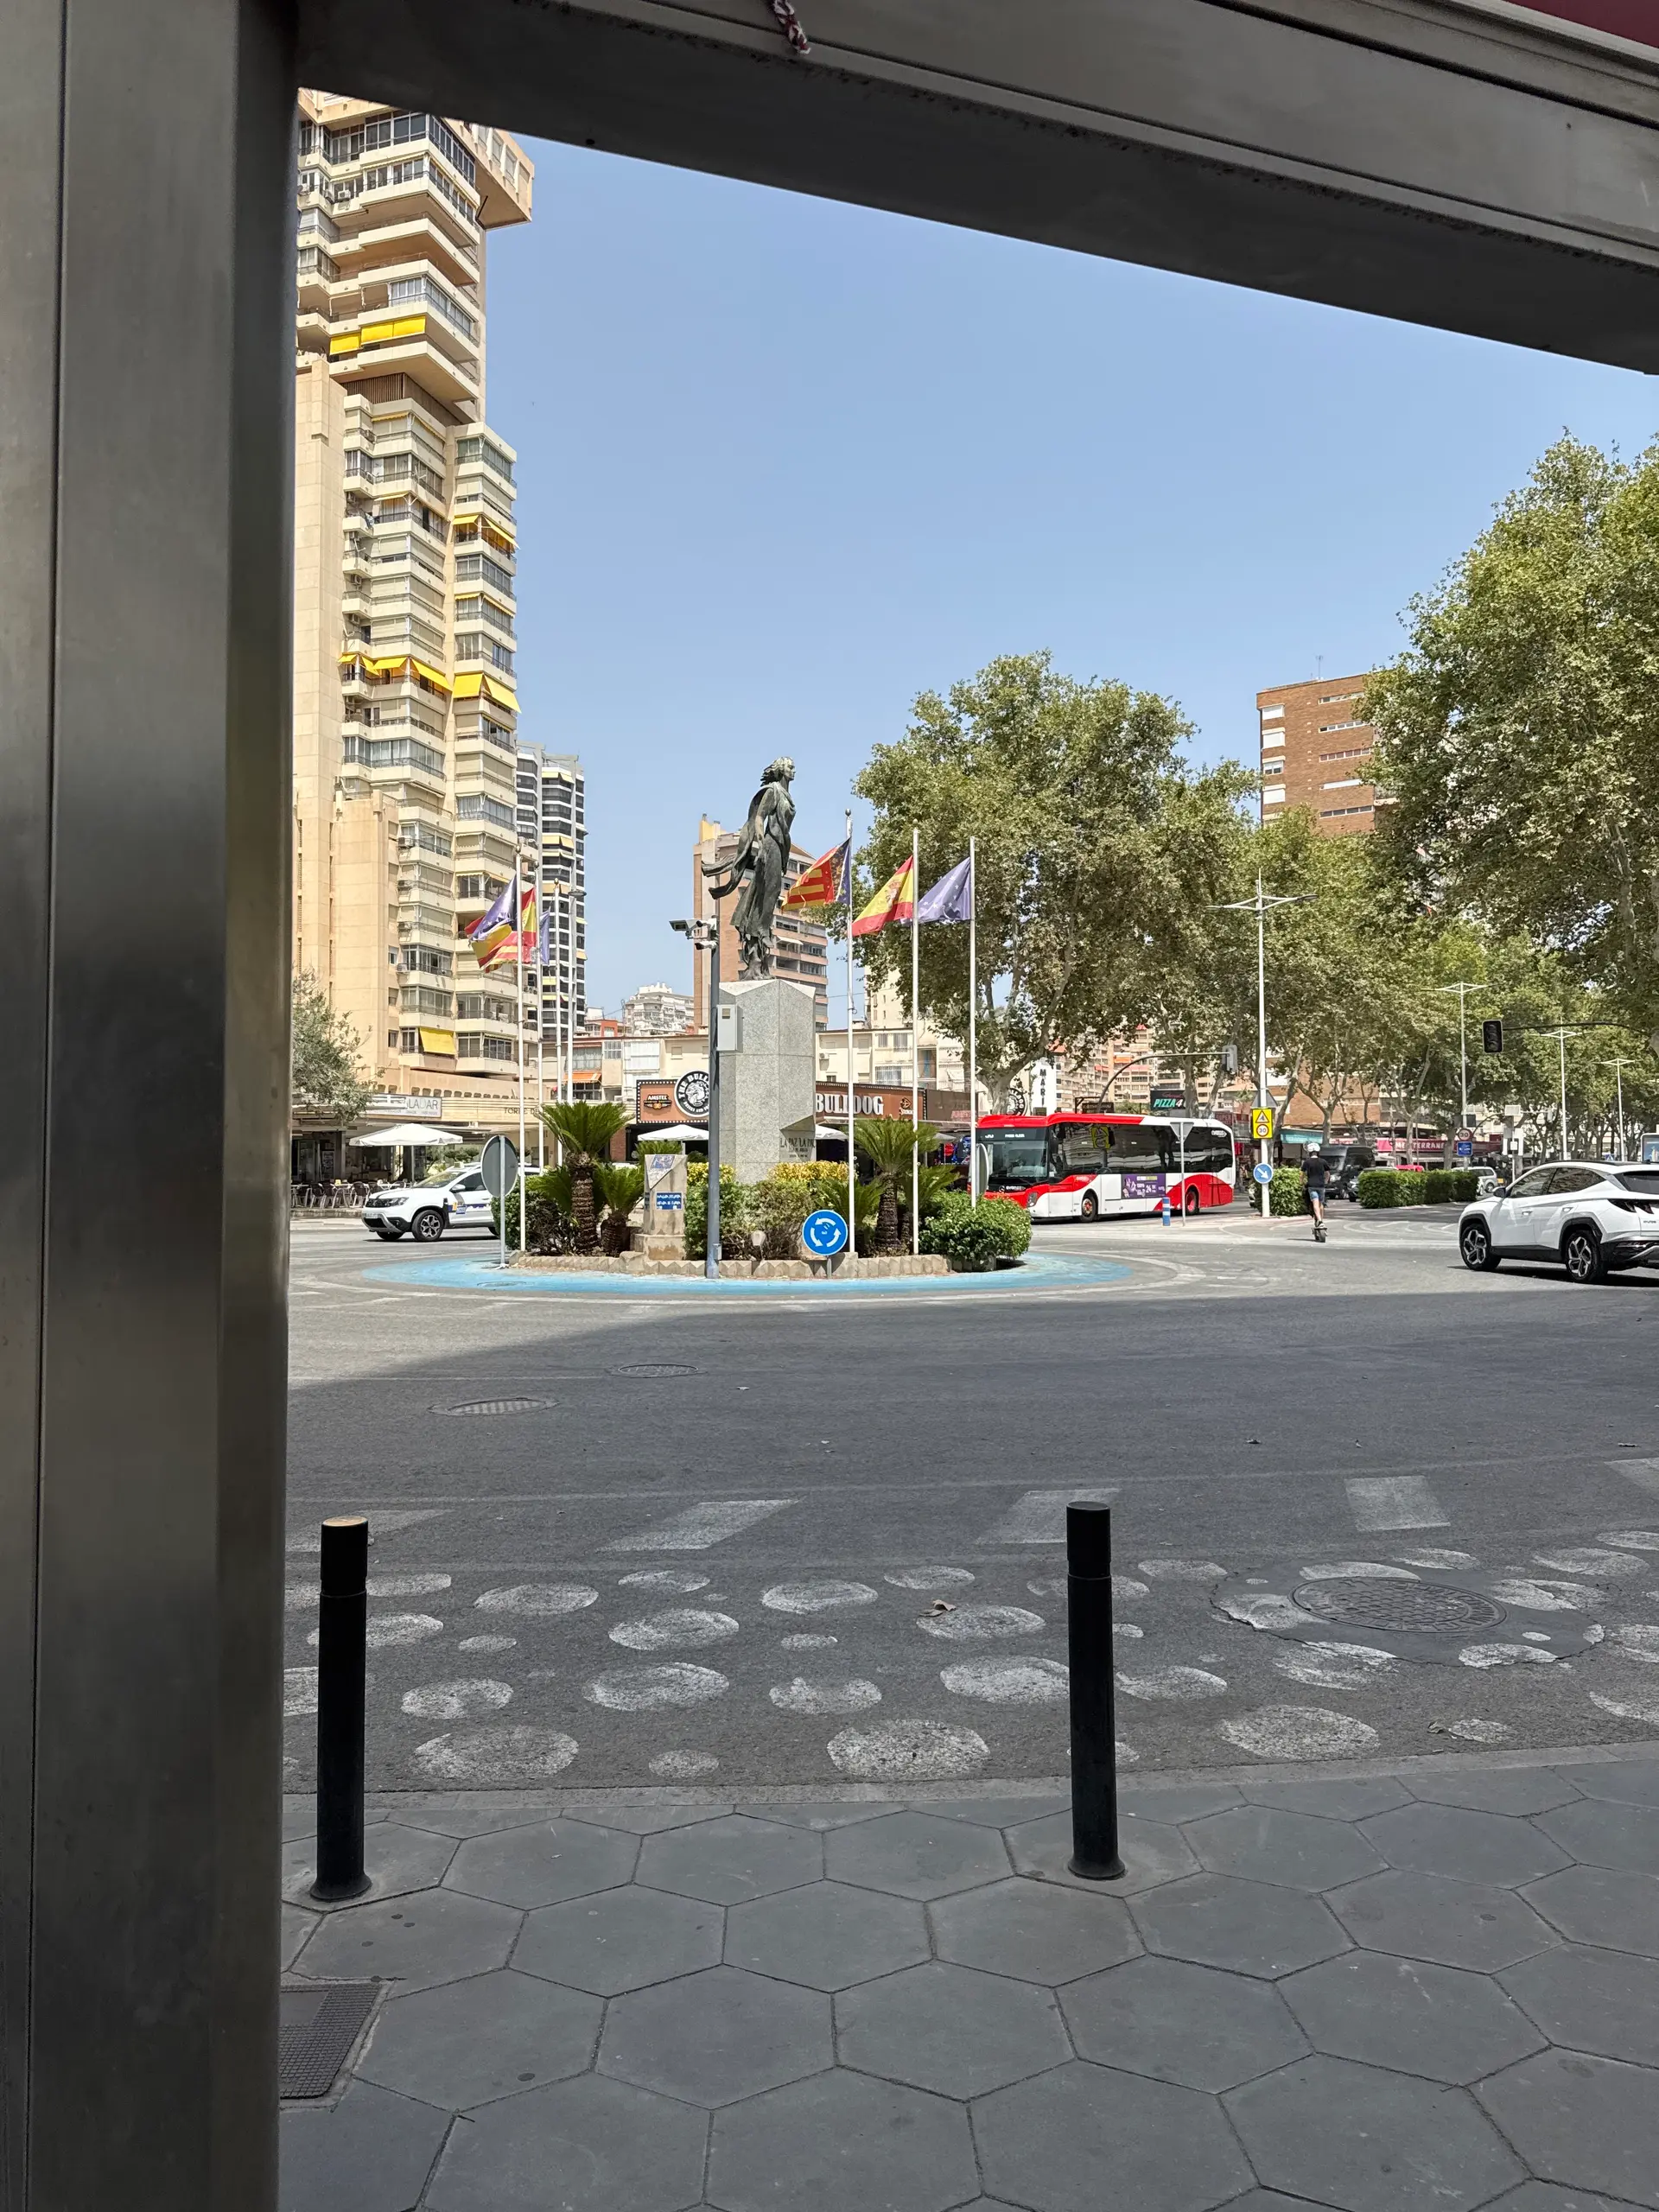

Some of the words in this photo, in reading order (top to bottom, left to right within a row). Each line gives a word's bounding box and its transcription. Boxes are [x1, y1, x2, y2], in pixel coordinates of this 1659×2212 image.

[678, 1080, 689, 1099] THE
[687, 1072, 709, 1083] BULL
[815, 1093, 884, 1116] BULLDOG
[1154, 1098, 1176, 1108] PIZZA
